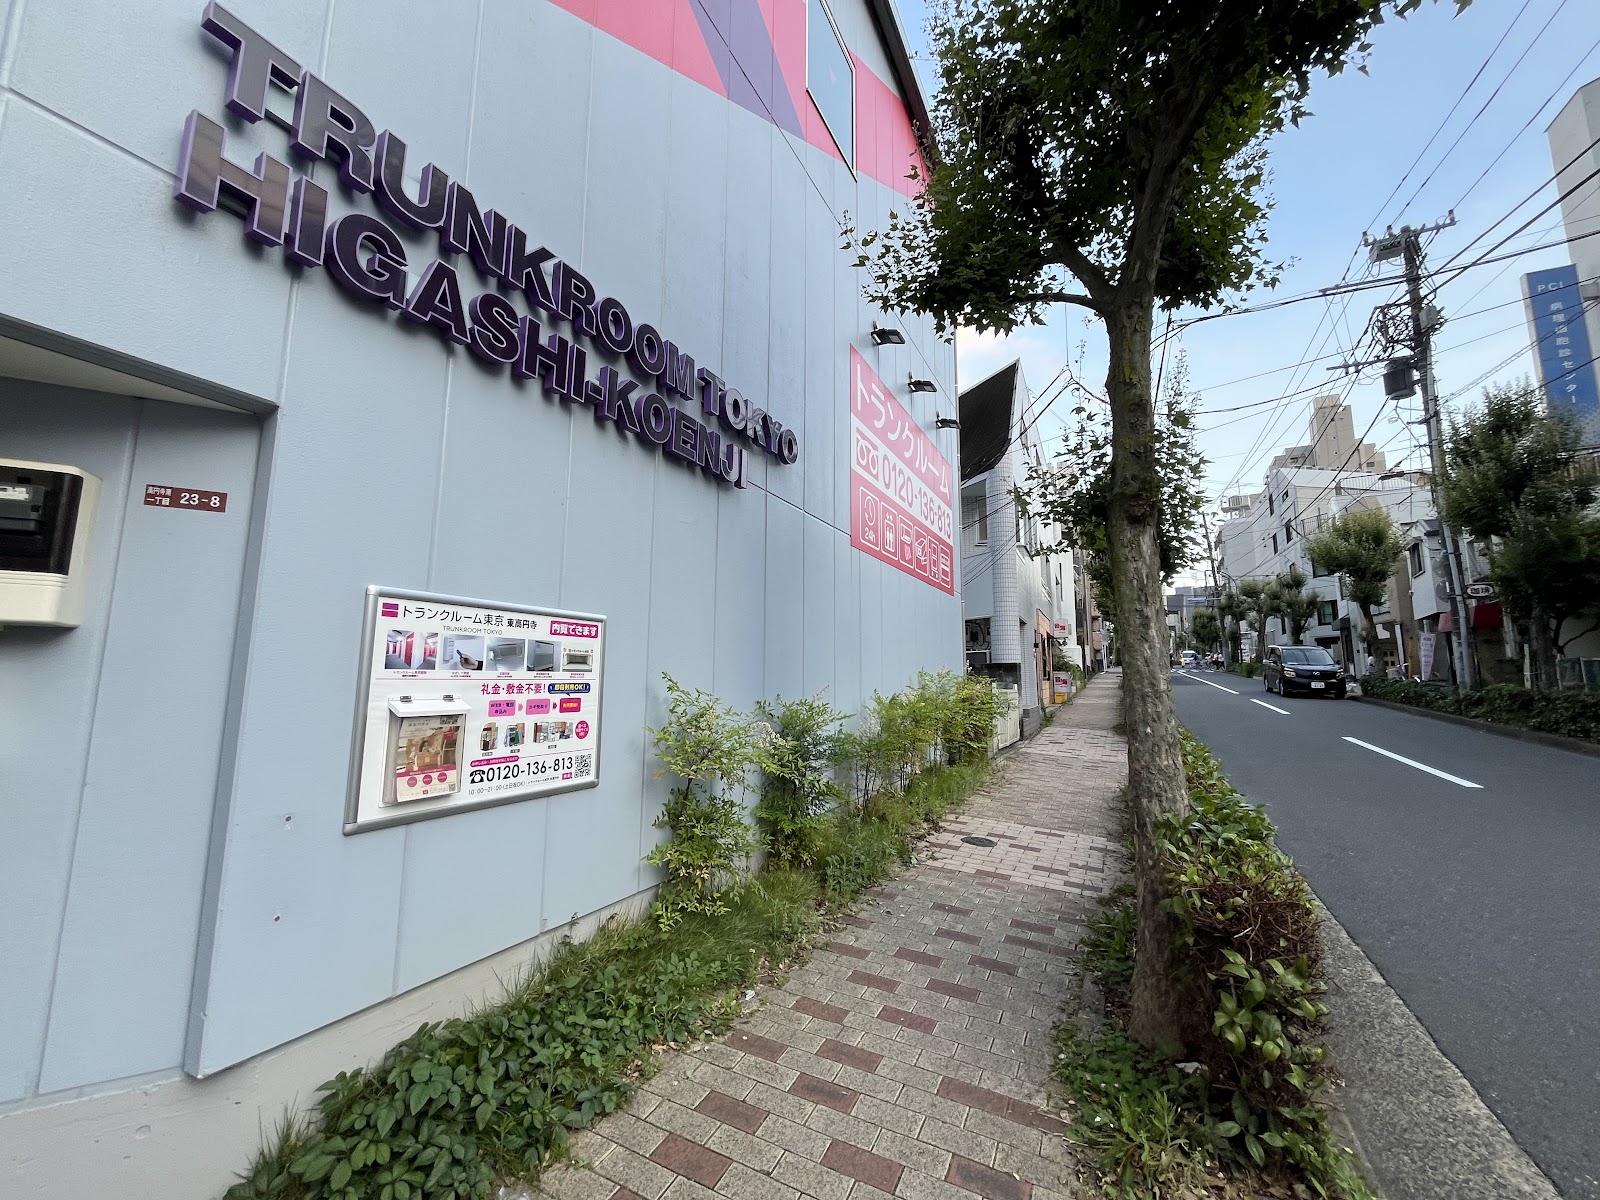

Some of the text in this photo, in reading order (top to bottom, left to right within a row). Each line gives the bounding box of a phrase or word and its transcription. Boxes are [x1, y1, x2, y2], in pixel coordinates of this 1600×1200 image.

[200, 1, 799, 466] TRUNKROOM TOKYO
[1537, 280, 1567, 294] PCI
[174, 109, 750, 491] HIGASHI-KOENJI
[856, 363, 951, 501] トランクルーム
[146, 496, 170, 506] 一丁目
[180, 492, 221, 508] 23-8
[864, 526, 876, 545] 24h
[403, 605, 537, 630] トランクルーム東京 東高円寺
[443, 625, 482, 634] TRUNKROOM
[551, 623, 597, 637] 内覧できます
[486, 756, 573, 782] 0120-136-813
